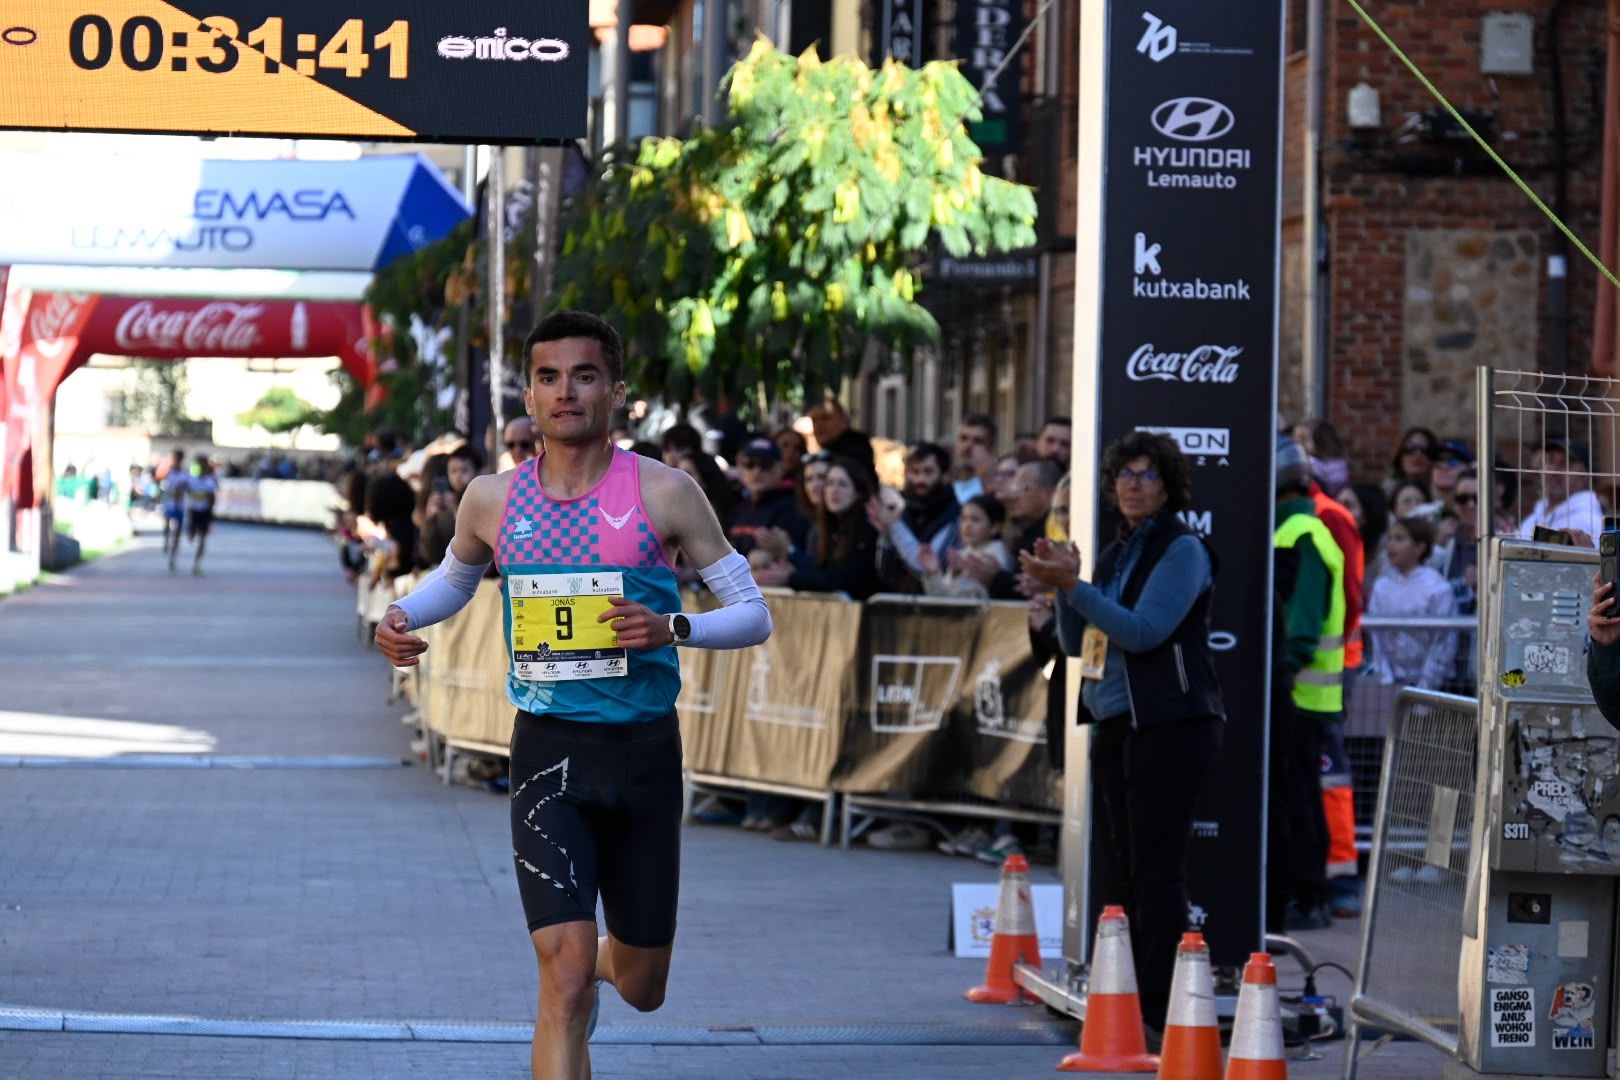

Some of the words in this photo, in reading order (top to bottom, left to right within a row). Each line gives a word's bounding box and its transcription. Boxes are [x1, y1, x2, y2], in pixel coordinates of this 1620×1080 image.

[69, 14, 409, 79] 00:31:41
[437, 27, 569, 61] emico
[1133, 147, 1251, 169] HYUNDAI
[1147, 171, 1237, 189] Lemauto
[1133, 232, 1162, 275] k
[1133, 277, 1251, 300] kutxabank
[1126, 343, 1244, 383] Coca-Cola
[550, 598, 576, 607] JONÁS
[555, 606, 573, 640] 9
[1496, 990, 1529, 1001] GANSO
[1494, 1001, 1532, 1012] ENIGMA
[1501, 1011, 1526, 1022] ANUS
[1495, 1021, 1533, 1033] WOHOU
[1499, 1032, 1530, 1043] FRENO
